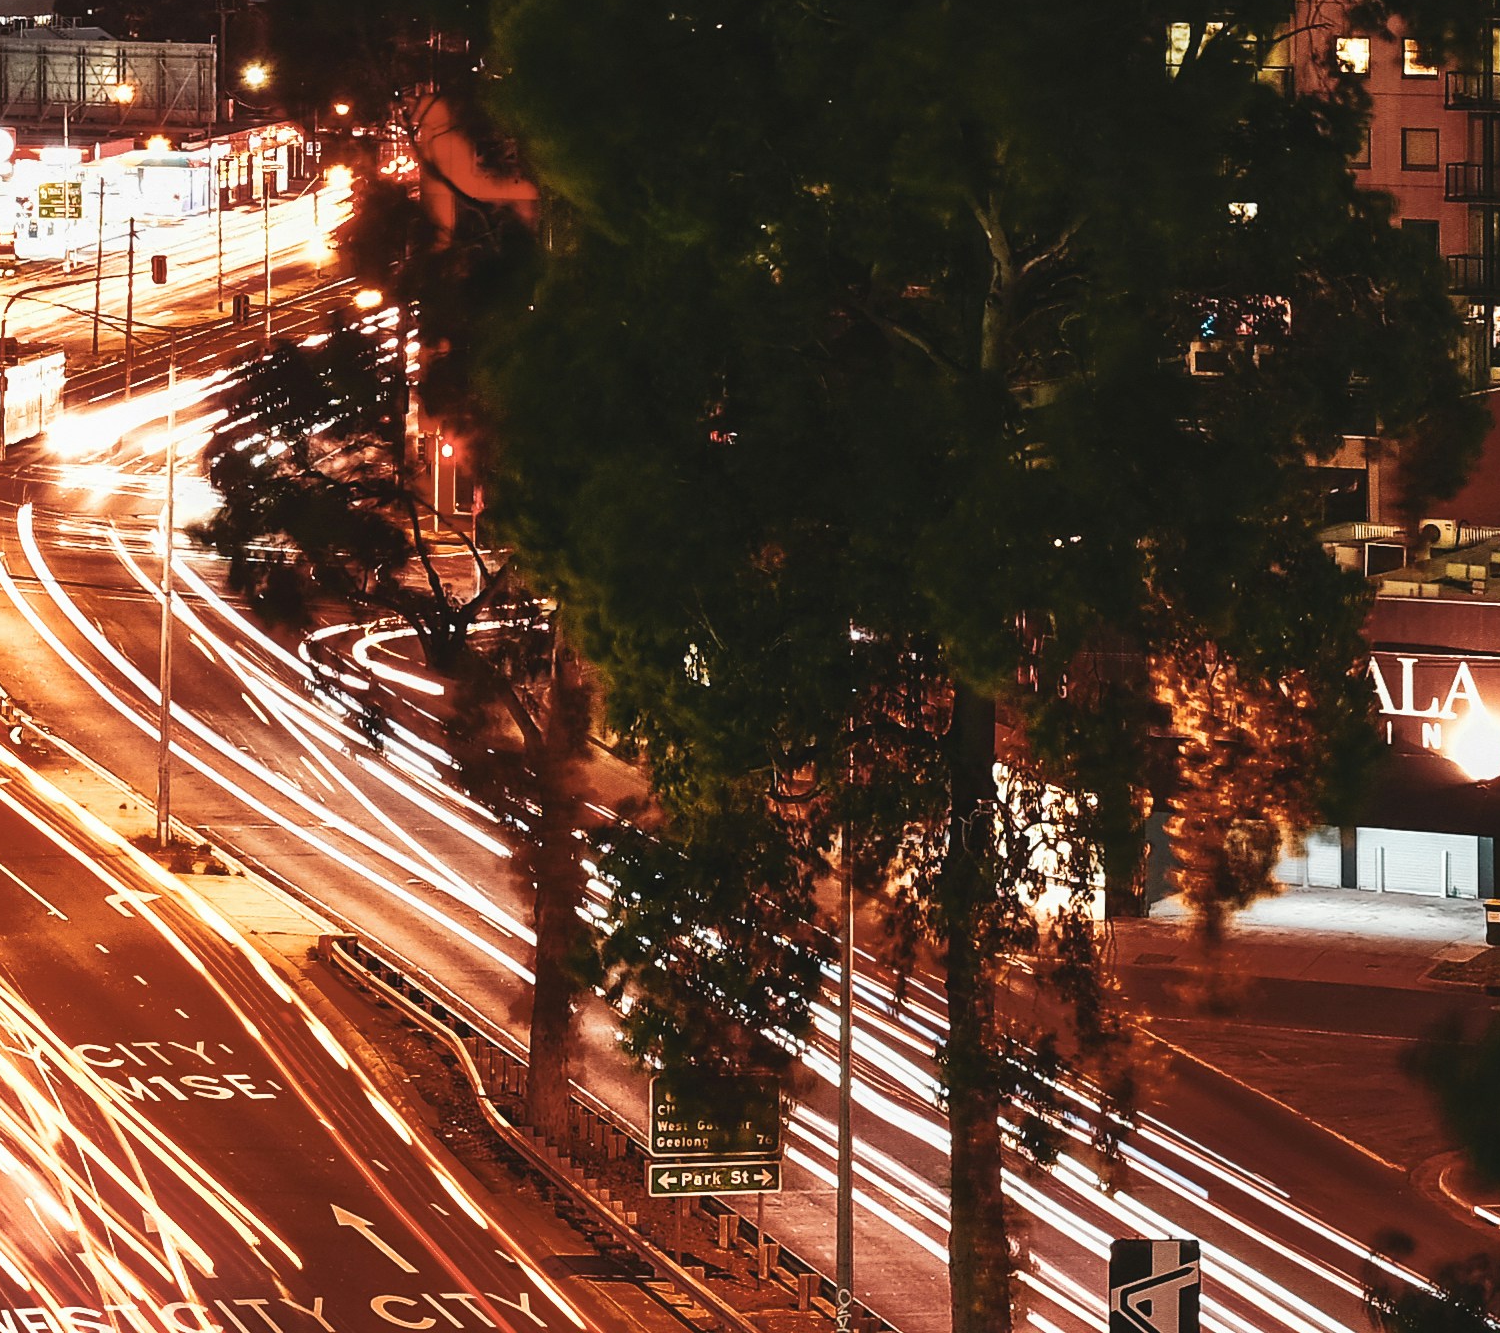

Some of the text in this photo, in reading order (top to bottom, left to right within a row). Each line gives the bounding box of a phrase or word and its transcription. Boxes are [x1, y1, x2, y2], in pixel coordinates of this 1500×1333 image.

[73, 1041, 216, 1069] CITY
[656, 1136, 709, 1150] Geelong
[681, 1170, 749, 1187] Park St
[369, 1292, 549, 1330] CITY
